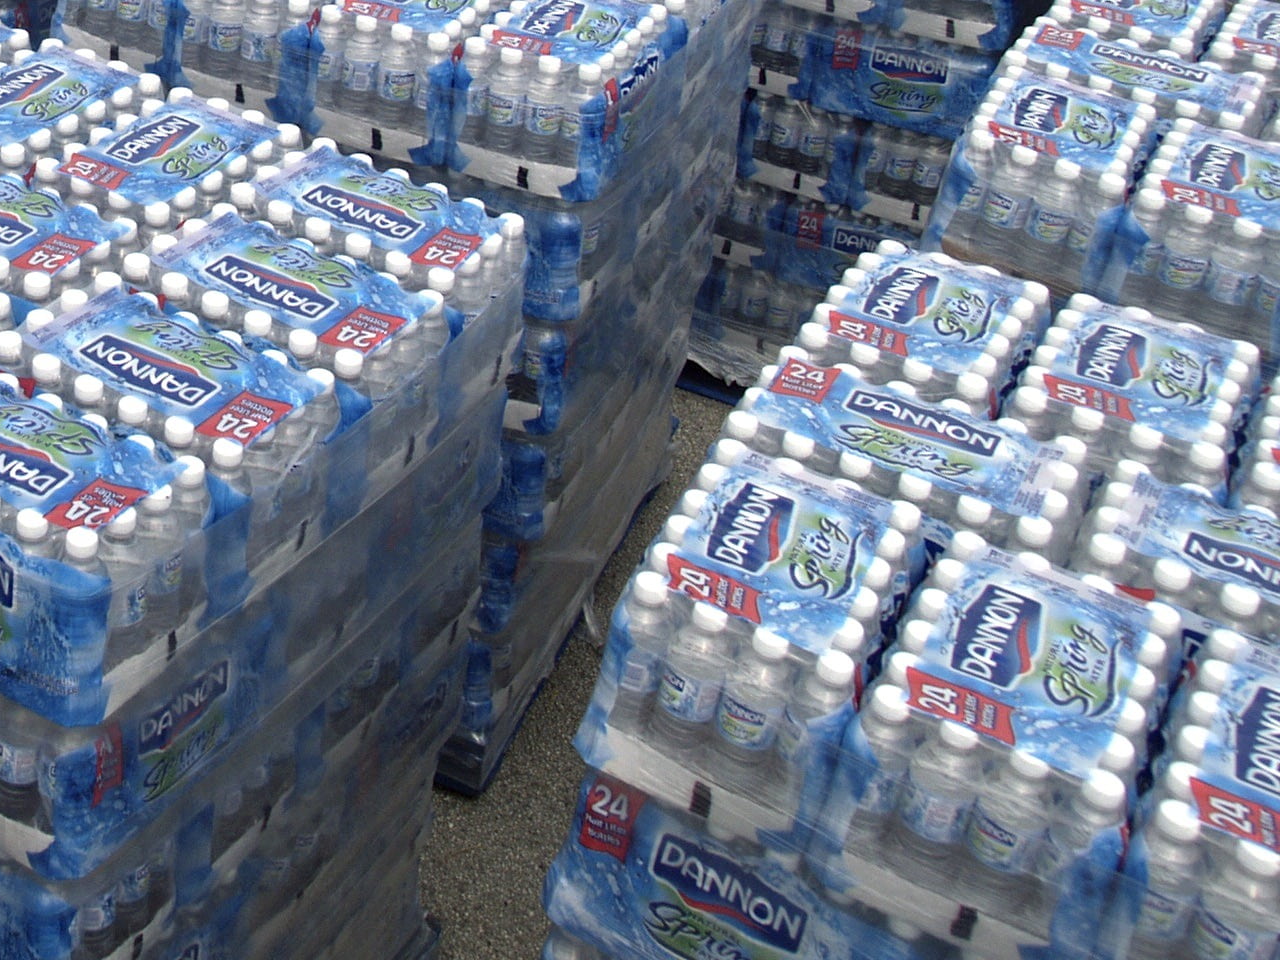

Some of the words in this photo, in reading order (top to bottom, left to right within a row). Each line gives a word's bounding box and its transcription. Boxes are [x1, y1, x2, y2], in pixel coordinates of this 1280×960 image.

[523, 0, 578, 35] DANNON
[836, 31, 857, 52] 24
[873, 45, 950, 84] DANNON
[1098, 45, 1208, 82] DANNON
[20, 79, 89, 121] Spring
[869, 81, 940, 115] Spring
[117, 116, 191, 164] DANNON
[162, 132, 230, 180] Spring
[68, 159, 99, 177] 24
[309, 189, 413, 236] DANNON
[800, 214, 821, 233] 24
[28, 250, 65, 270] 24
[423, 245, 461, 265] 24
[211, 261, 326, 316] DANNON
[868, 268, 926, 321] DANNON
[133, 321, 239, 371] Spring
[335, 324, 379, 348] 24
[837, 318, 868, 340] 24
[86, 341, 207, 403] DANNON
[789, 363, 826, 383] 24
[1083, 326, 1133, 384] DANNON
[216, 413, 260, 438] 24
[854, 393, 995, 451] DANNON
[65, 500, 113, 526] 24
[715, 486, 780, 566] DANNON
[788, 516, 851, 598] Spring
[677, 566, 711, 597] 24
[959, 589, 1025, 681] DANNON
[1042, 623, 1109, 716] Spring
[918, 684, 959, 716] 24
[591, 783, 629, 821] 24
[1209, 796, 1253, 834] 24
[659, 842, 801, 940] DANNON
